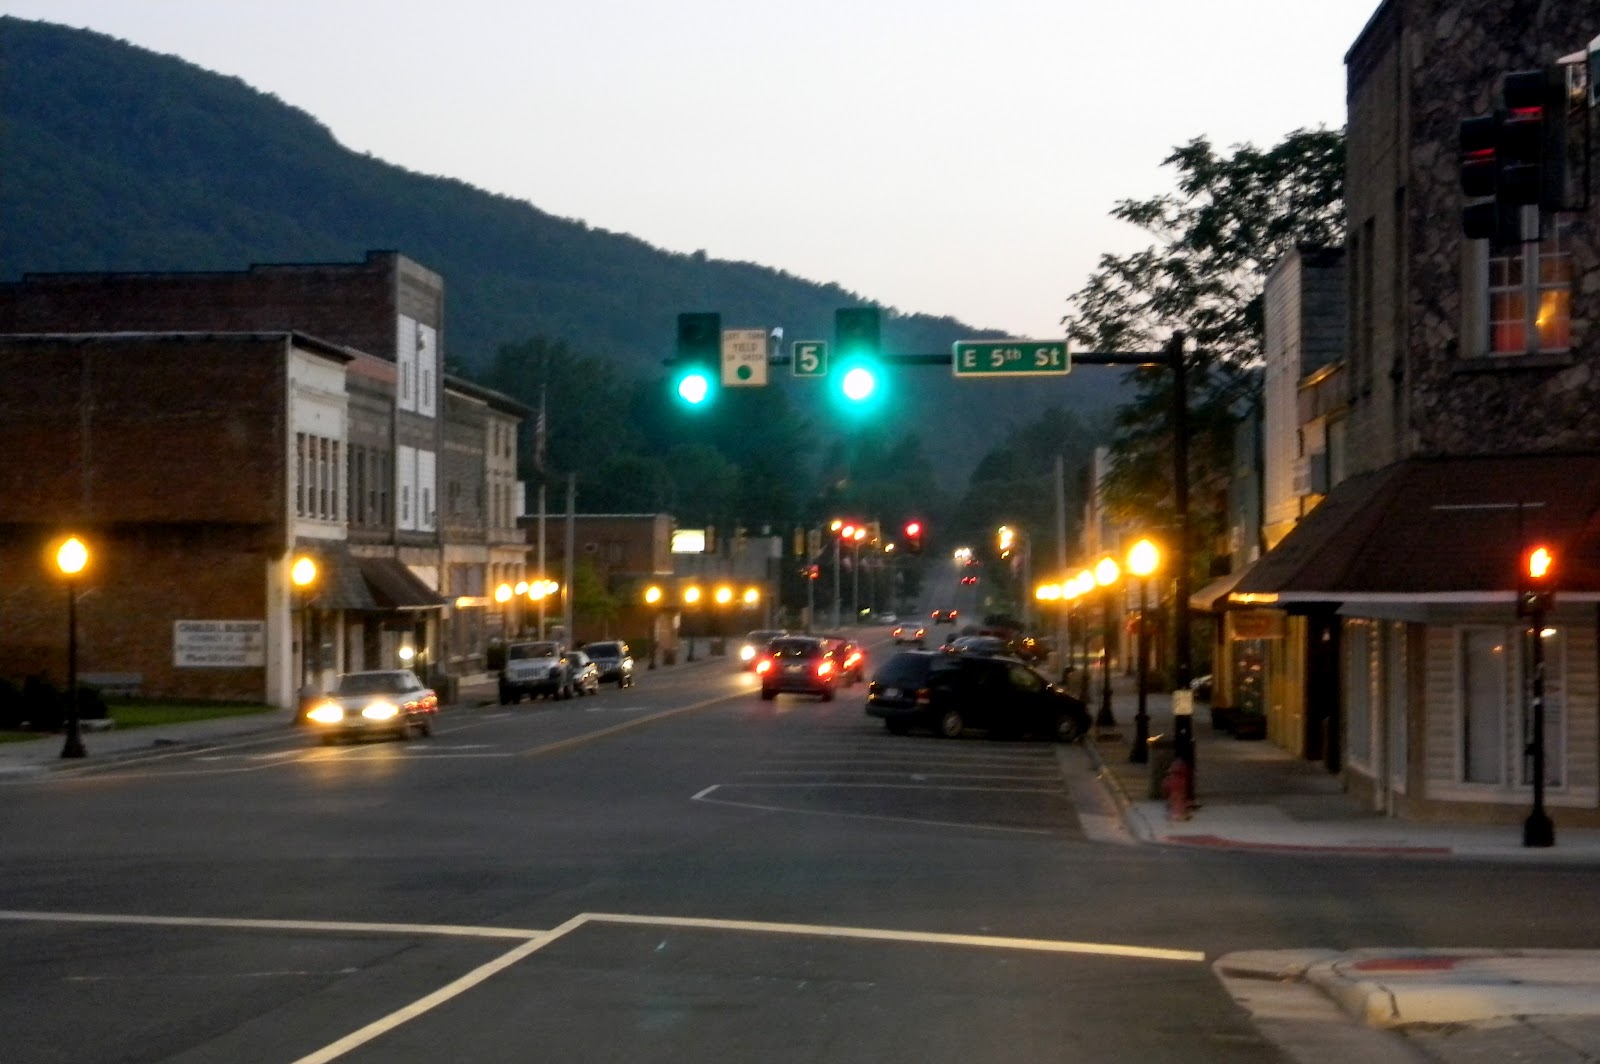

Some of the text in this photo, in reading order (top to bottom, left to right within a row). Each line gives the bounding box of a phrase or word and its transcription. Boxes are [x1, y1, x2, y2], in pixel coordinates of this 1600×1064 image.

[800, 346, 819, 371] 5
[963, 349, 977, 367] E
[1034, 347, 1060, 366] St
